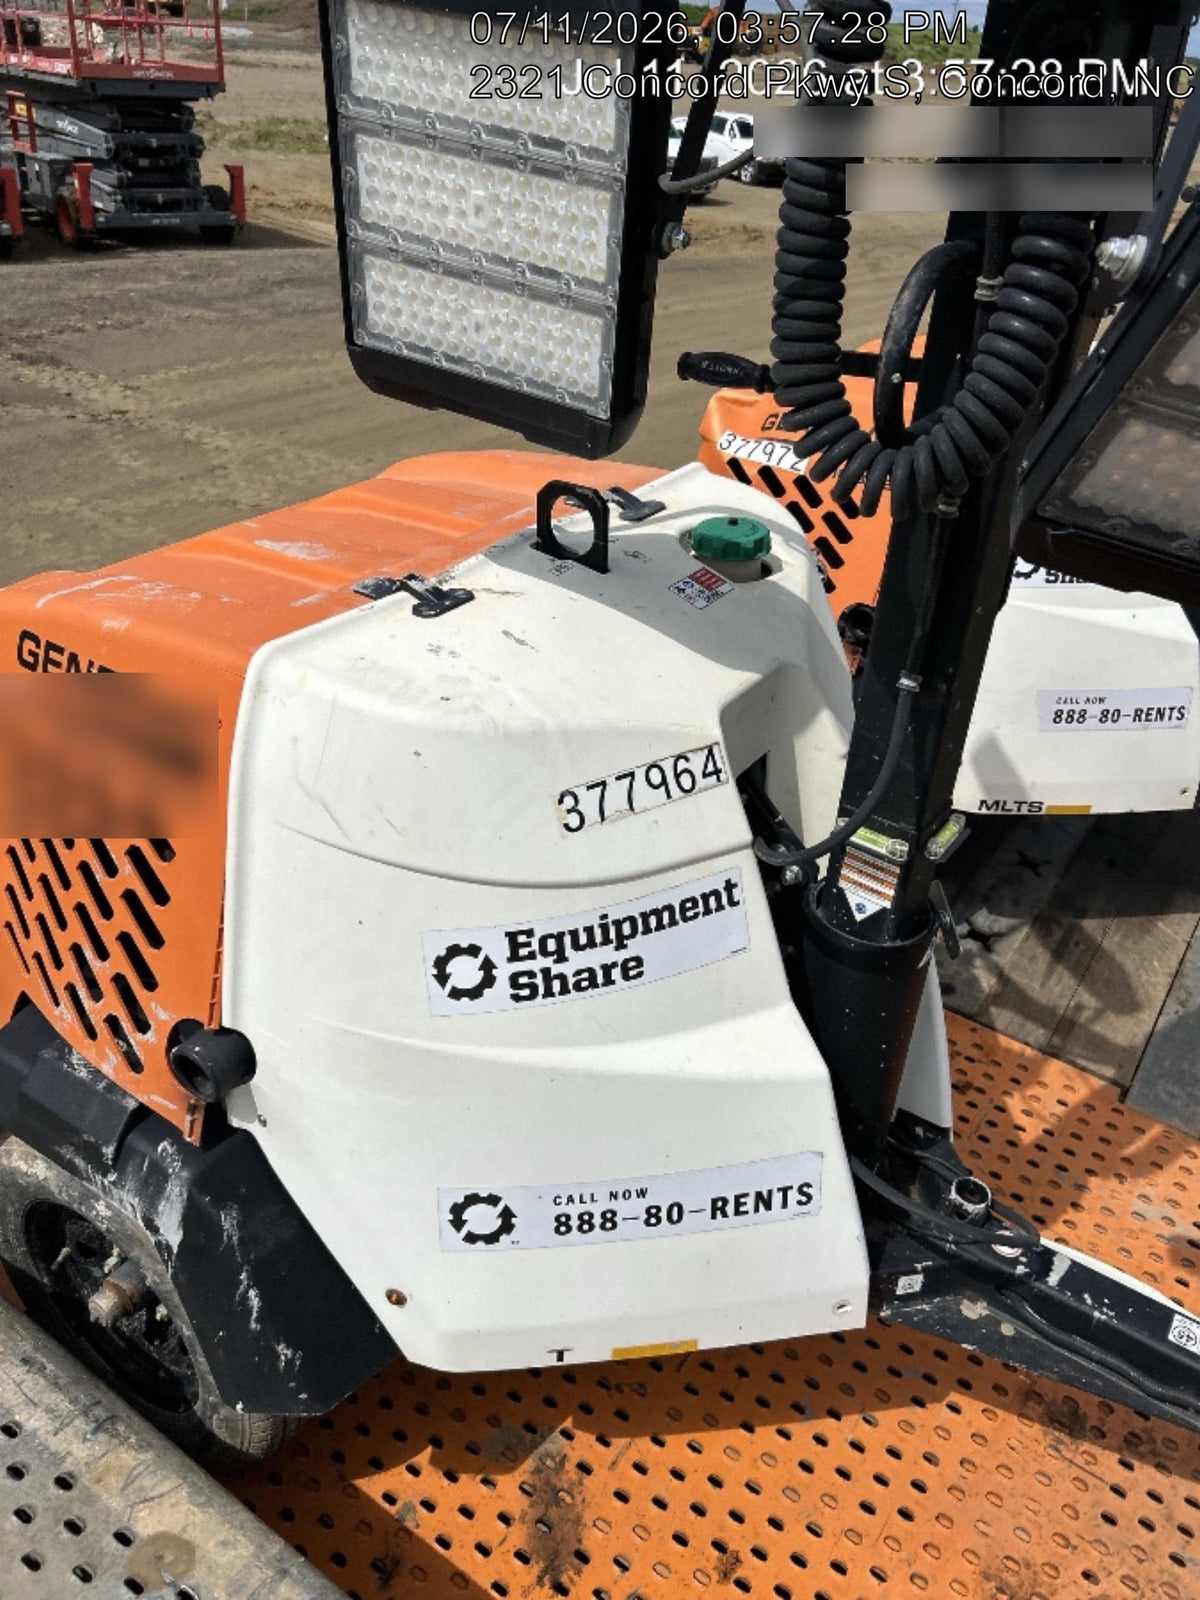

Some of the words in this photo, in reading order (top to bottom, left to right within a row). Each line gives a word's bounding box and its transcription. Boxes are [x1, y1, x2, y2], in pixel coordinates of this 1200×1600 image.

[1052, 705, 1186, 724] 888-80-RENTS
[557, 745, 722, 833] 377964
[977, 800, 1044, 813] MLTS
[505, 878, 741, 965] Equipment
[508, 955, 645, 1003] Share
[552, 1193, 600, 1207] CALL
[609, 1187, 649, 1202] NOW
[553, 1181, 814, 1237] 888-80-RENTS
